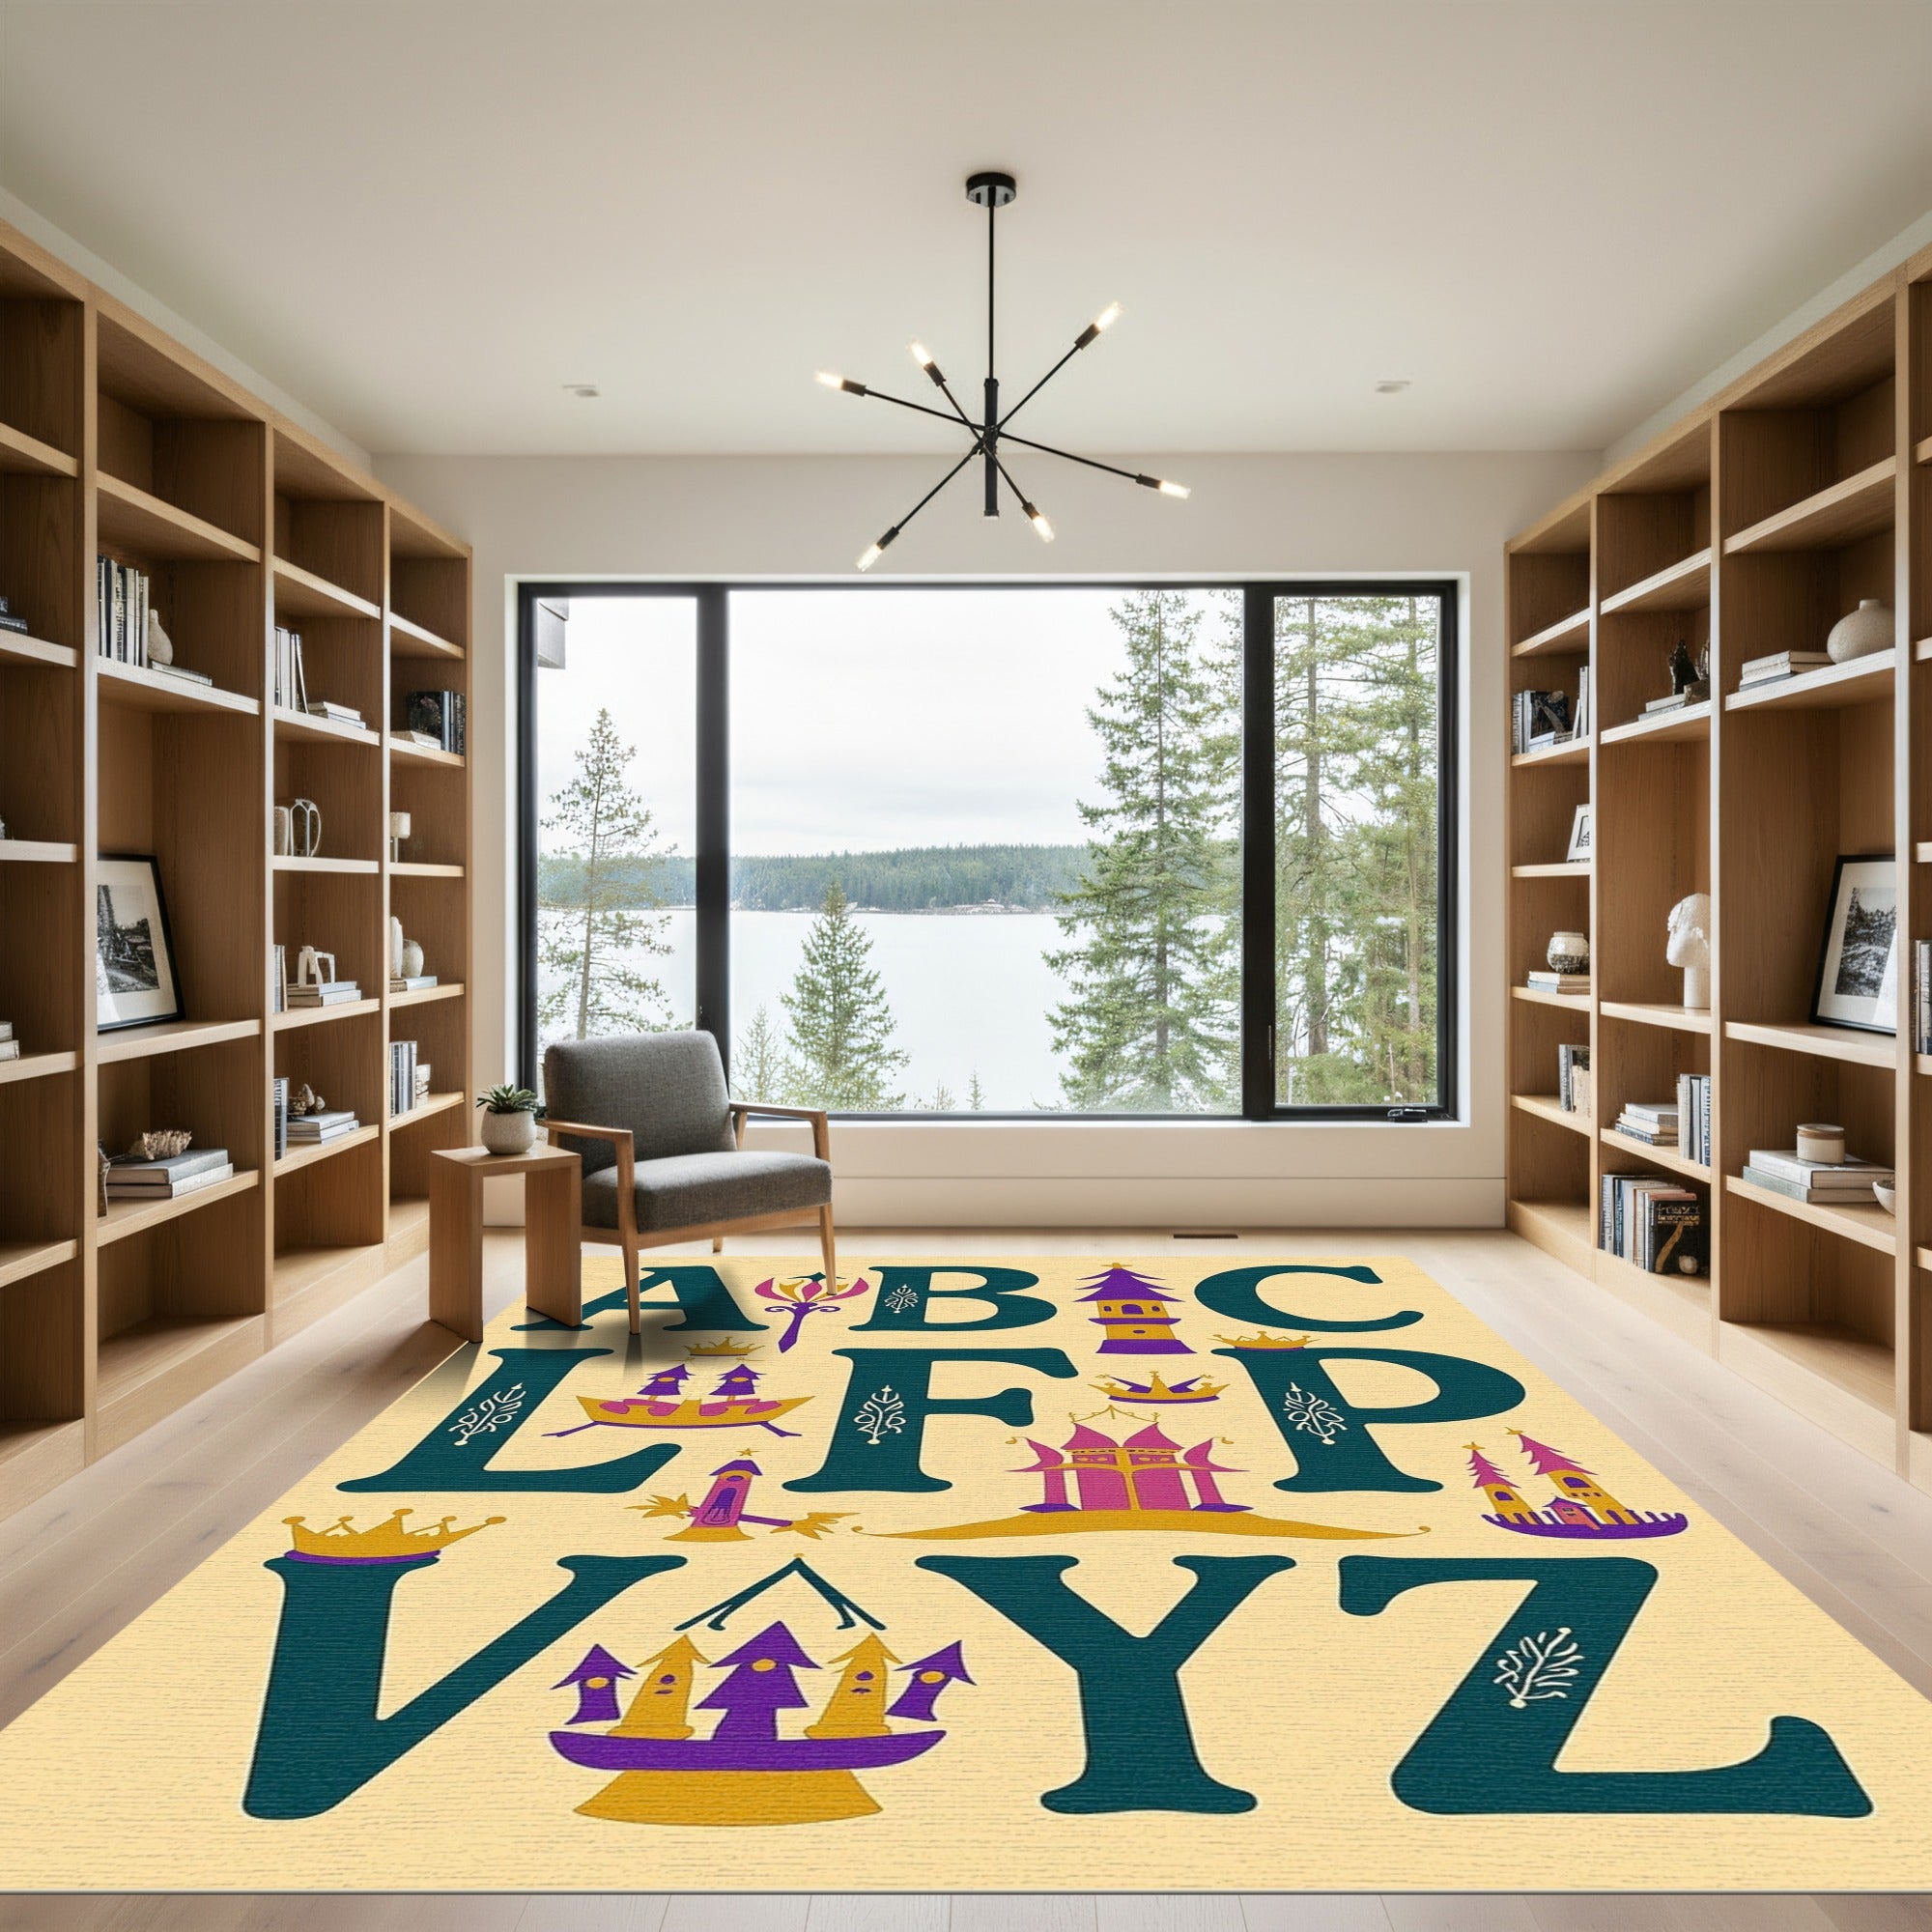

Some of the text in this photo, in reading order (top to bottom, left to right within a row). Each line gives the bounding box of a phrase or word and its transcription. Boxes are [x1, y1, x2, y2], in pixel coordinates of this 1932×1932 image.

[510, 1264, 1424, 1332] A B C
[337, 1348, 1525, 1493] L F P
[242, 1554, 1873, 1819] V Y Z
